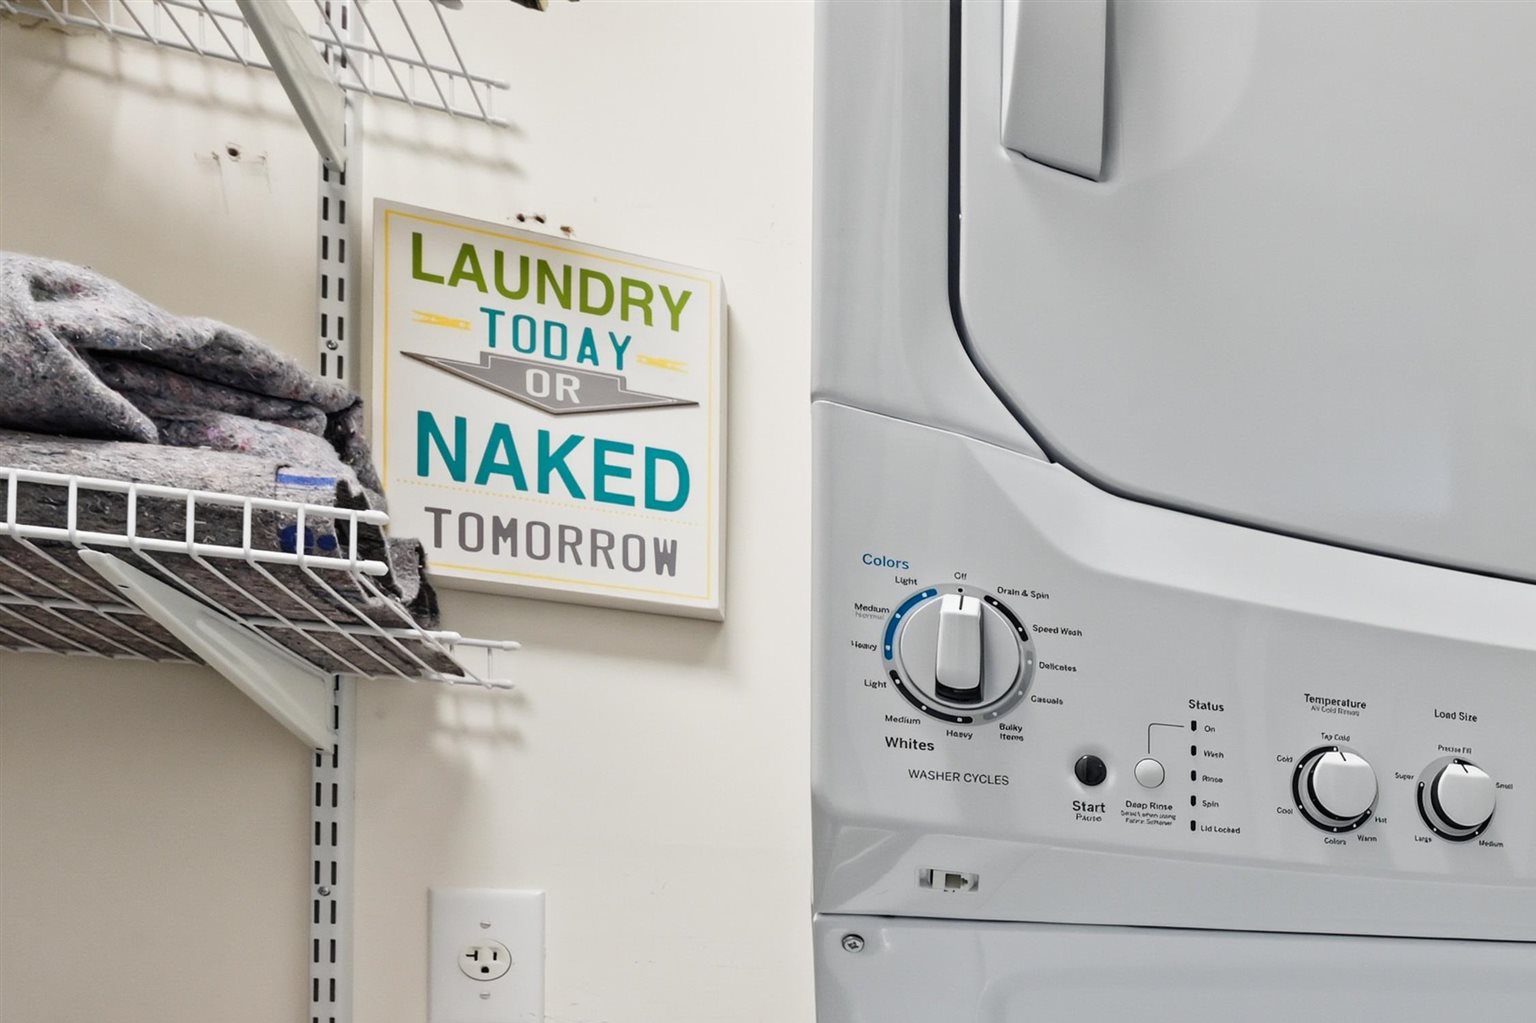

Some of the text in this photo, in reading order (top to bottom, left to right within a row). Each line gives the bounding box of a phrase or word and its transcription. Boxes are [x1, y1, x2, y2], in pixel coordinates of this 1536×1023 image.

[411, 232, 692, 332] LAUNDRY
[480, 307, 633, 371] TODAY
[525, 368, 582, 404] OR
[416, 410, 692, 513] NAKED
[424, 506, 679, 577] TOMORROW
[862, 553, 910, 570] Colors
[895, 576, 918, 586] Light
[954, 571, 967, 581] Off
[997, 586, 1050, 600] Drain & Spin
[854, 602, 890, 613] Medium
[1032, 624, 1083, 637] Speed Wash
[851, 640, 877, 651] Heavy
[1038, 661, 1077, 673] Delicates
[864, 679, 887, 689] Light
[1030, 694, 1064, 706] Casuals
[1188, 699, 1225, 712] Status
[1304, 693, 1367, 709] Temperature
[884, 714, 921, 725] Medium
[1434, 709, 1478, 723] Load Size
[999, 722, 1023, 733] Bulky
[1204, 725, 1216, 733] On
[946, 729, 974, 740] Heavy
[999, 732, 1024, 742] Items
[1321, 732, 1351, 742] Tap Cold
[884, 736, 935, 751] Whites
[1203, 749, 1225, 759] Wash
[1276, 754, 1293, 764] Cold
[908, 768, 1010, 786] WASHER CYCLES
[1201, 775, 1224, 784] Rinse
[1395, 772, 1414, 781] Super
[1495, 781, 1514, 790] Small
[1072, 800, 1106, 814] Start
[1125, 800, 1173, 811] Deep Rinse
[1201, 799, 1220, 809] Spin
[1276, 806, 1293, 815] Cool
[1374, 815, 1388, 824] Hot
[1200, 824, 1241, 834] Lid Locked
[1324, 836, 1347, 846] Colors
[1357, 834, 1377, 843] Warm
[1414, 834, 1432, 844] Large
[1478, 839, 1504, 849] Medium
